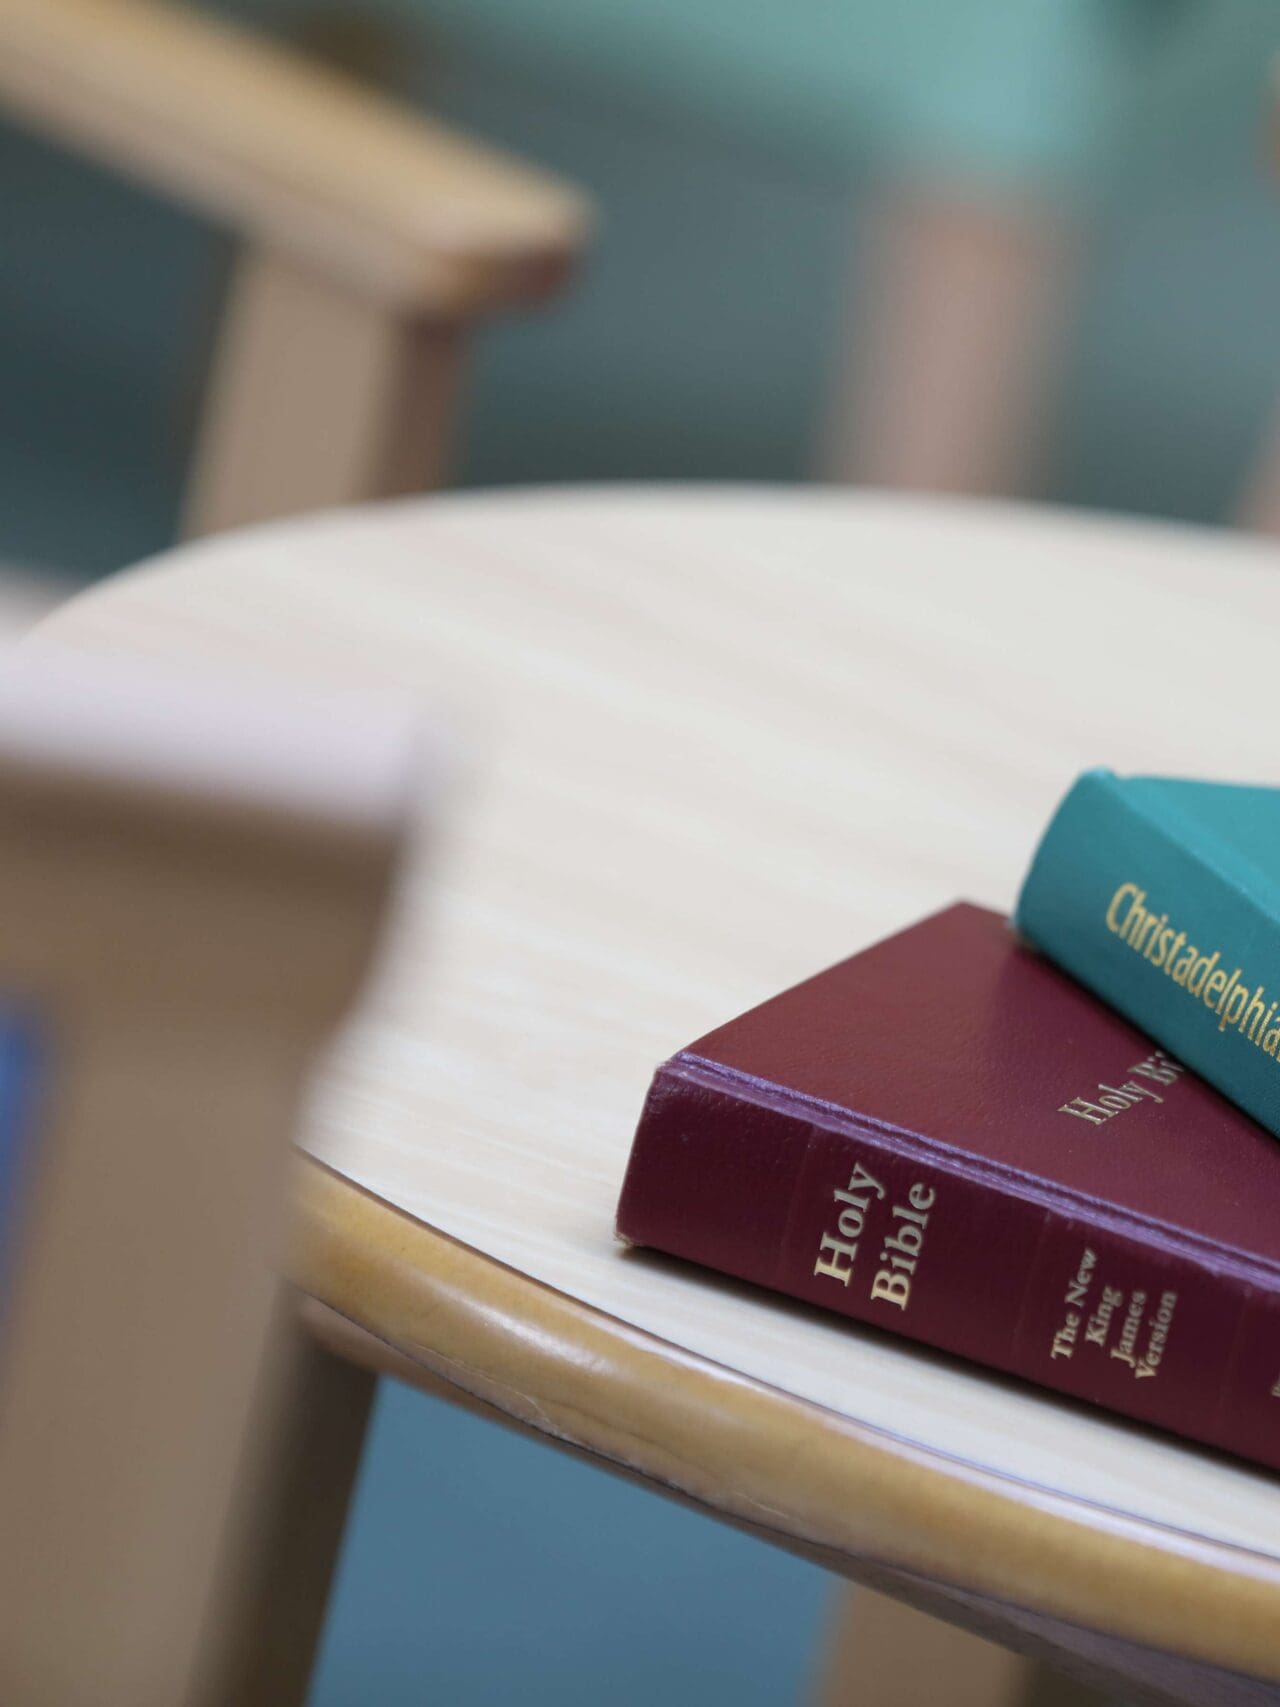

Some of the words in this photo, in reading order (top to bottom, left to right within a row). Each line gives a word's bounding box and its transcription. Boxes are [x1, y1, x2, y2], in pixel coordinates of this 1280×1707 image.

[1056, 1080, 1164, 1125] Holy
[813, 1162, 886, 1288] Holy
[870, 1182, 937, 1312] Bible
[1064, 1247, 1098, 1309] New
[1050, 1312, 1081, 1361] The
[1084, 1284, 1124, 1348] King
[1110, 1289, 1148, 1369] James
[1134, 1289, 1179, 1380] Version
